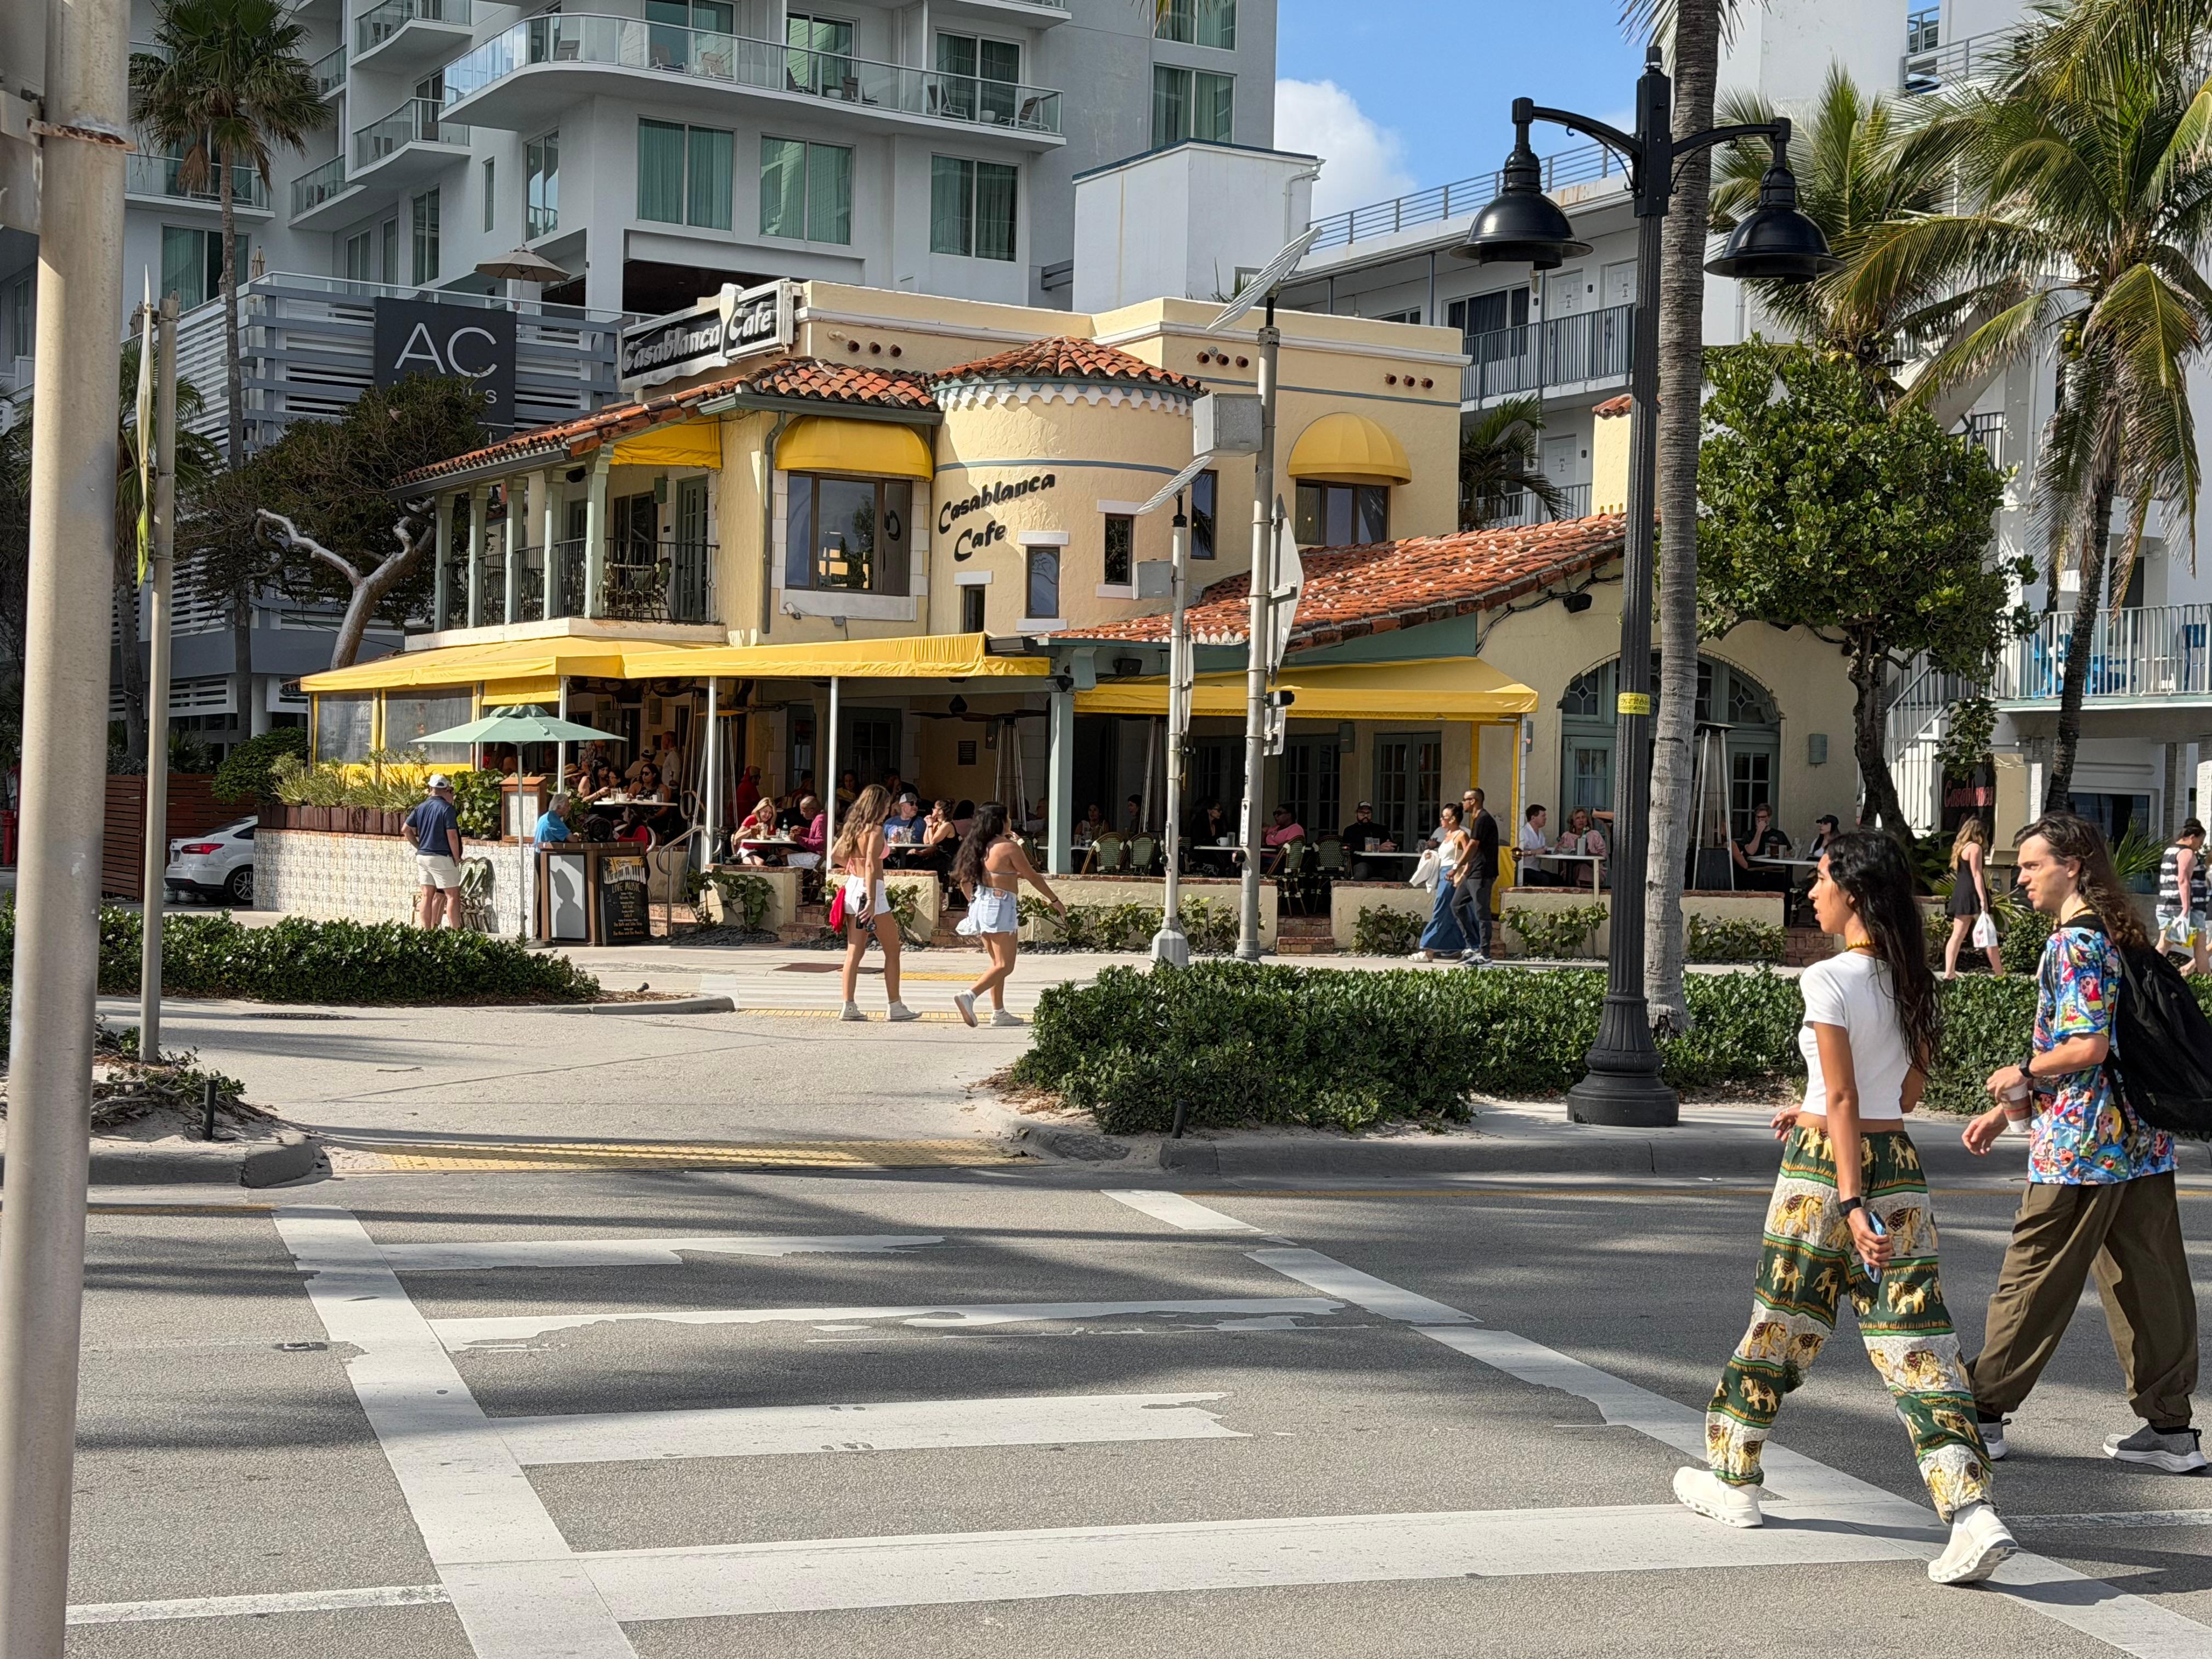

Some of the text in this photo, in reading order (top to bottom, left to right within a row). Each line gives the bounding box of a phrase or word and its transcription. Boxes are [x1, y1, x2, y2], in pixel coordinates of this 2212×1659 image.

[393, 323, 498, 378] AC
[623, 302, 773, 372] Casablanca Cafe
[938, 474, 1056, 534] Casablanca
[953, 520, 1006, 562] Cafe
[1944, 778, 1994, 808] Casablanca
[612, 881, 641, 893] LIVE MUSIC
